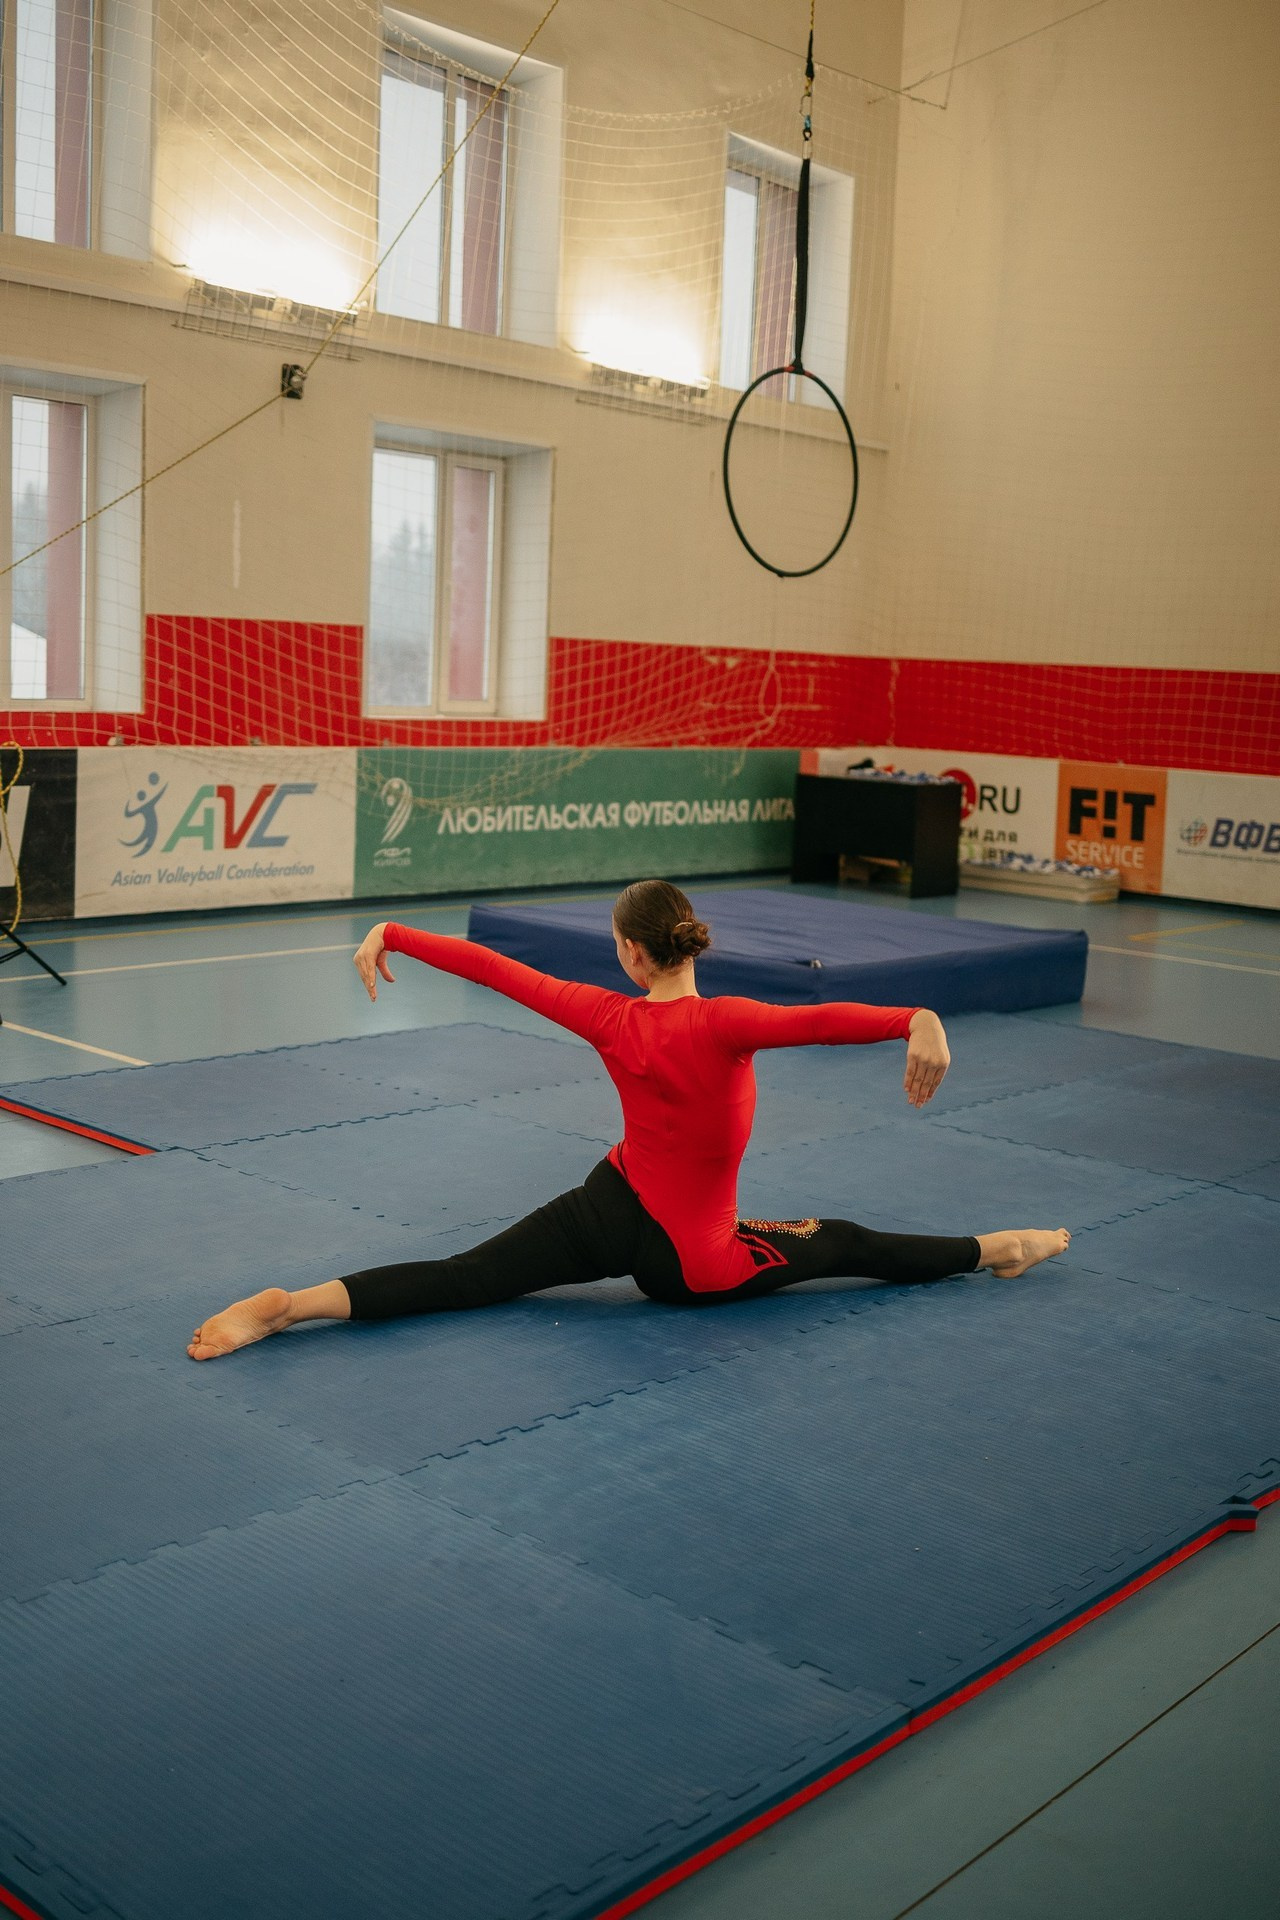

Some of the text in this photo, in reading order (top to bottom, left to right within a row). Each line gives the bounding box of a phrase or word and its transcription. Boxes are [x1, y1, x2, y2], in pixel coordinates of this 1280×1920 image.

[161, 783, 319, 853] AVC
[437, 797, 796, 835] ЛЮБИТЕЛЬСКАЯ ФУТБОЛЬНАЯ ЛИГА
[1065, 839, 1145, 869] SERVICE
[111, 861, 315, 887] Asian Volleyball Confederation
